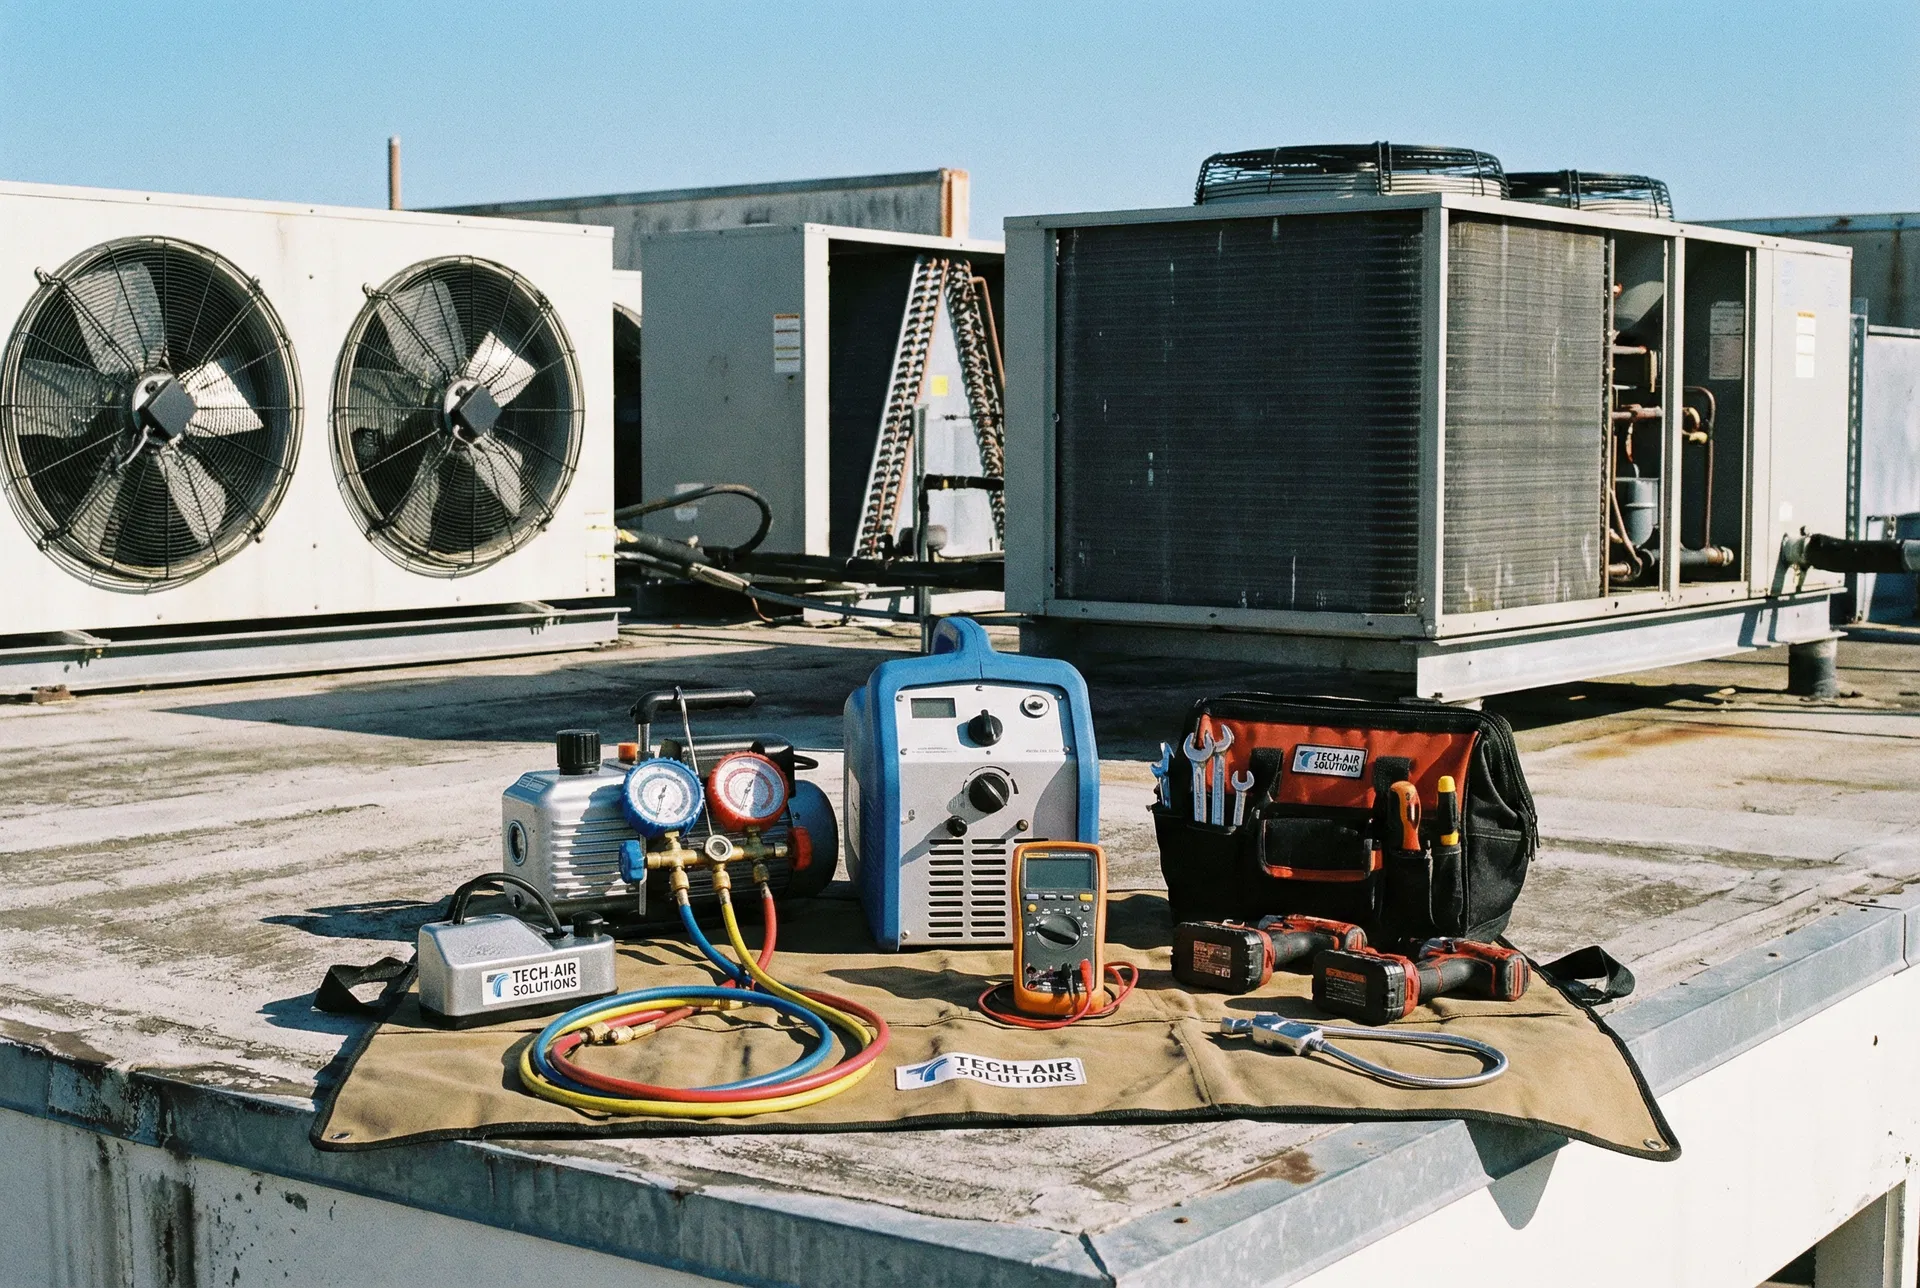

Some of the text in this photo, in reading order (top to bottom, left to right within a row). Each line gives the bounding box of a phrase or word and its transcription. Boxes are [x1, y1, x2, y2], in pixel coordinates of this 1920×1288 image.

[1314, 761, 1359, 773] SOLUTIONS
[1316, 752, 1360, 765] TECH-AIR
[512, 962, 577, 983] TECH-AIR
[513, 976, 577, 996] SOLUTIONS
[954, 1056, 1073, 1075] TECH-AIR
[956, 1067, 1077, 1084] SOLUTIONS
